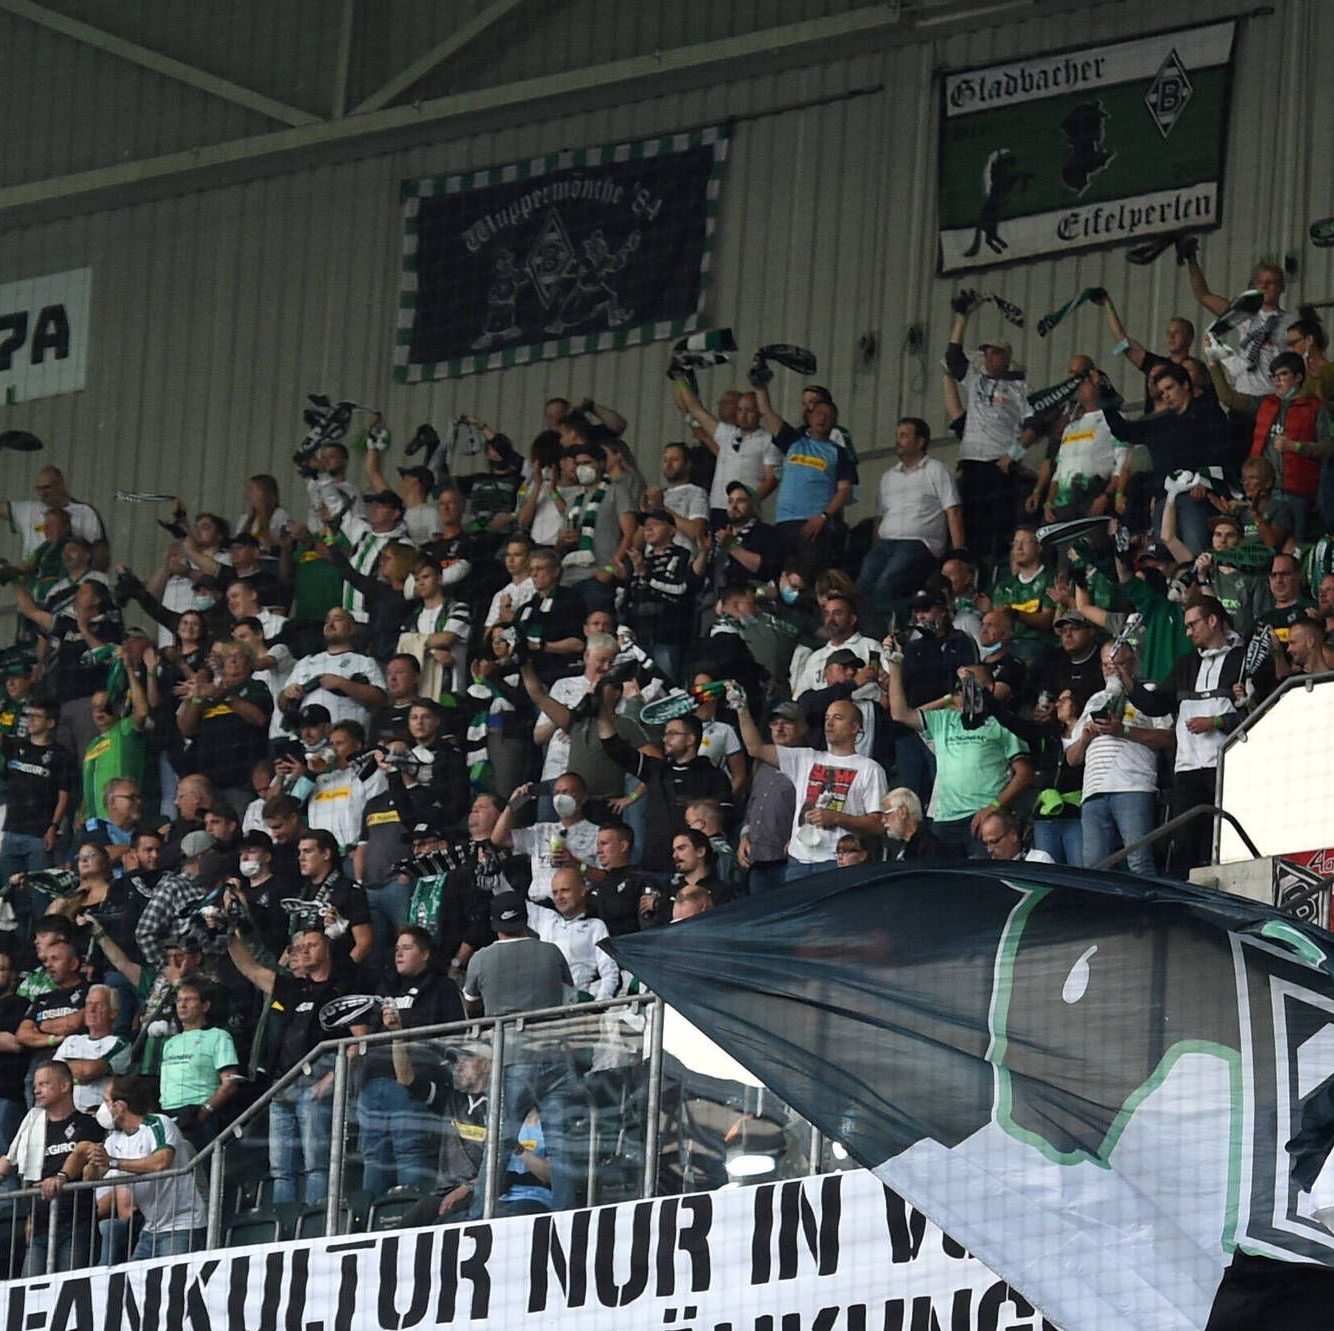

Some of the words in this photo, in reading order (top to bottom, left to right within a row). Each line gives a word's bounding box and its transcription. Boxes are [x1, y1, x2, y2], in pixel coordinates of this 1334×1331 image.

[950, 55, 1106, 107] Gladbacher
[1057, 195, 1212, 241] Eifelperlen
[527, 1193, 713, 1313] NUR
[750, 1174, 842, 1285] IN
